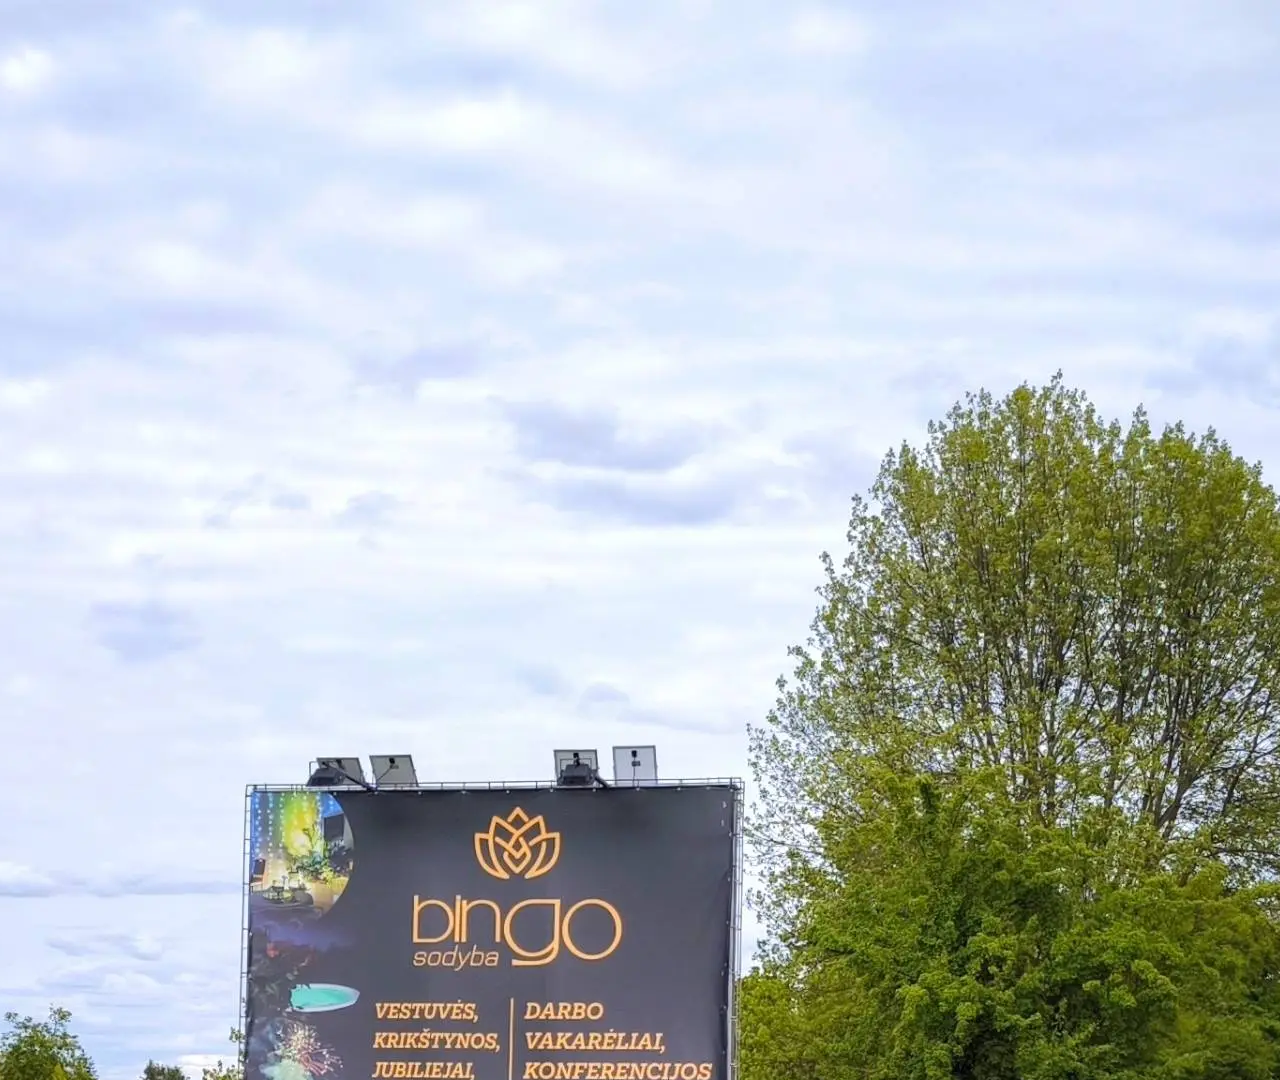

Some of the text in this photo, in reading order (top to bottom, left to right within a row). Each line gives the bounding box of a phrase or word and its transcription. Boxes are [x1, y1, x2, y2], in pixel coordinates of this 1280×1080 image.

[413, 894, 623, 967] bingo
[413, 947, 499, 970] sodyba
[375, 1000, 479, 1023] VESTUVĖS,
[524, 1002, 604, 1021] DARBO
[373, 1030, 500, 1053] KRIKŠTYNOS,
[525, 1030, 665, 1054] VAKARĖLIAI,
[523, 1061, 713, 1080] KONFERENCIJOS
